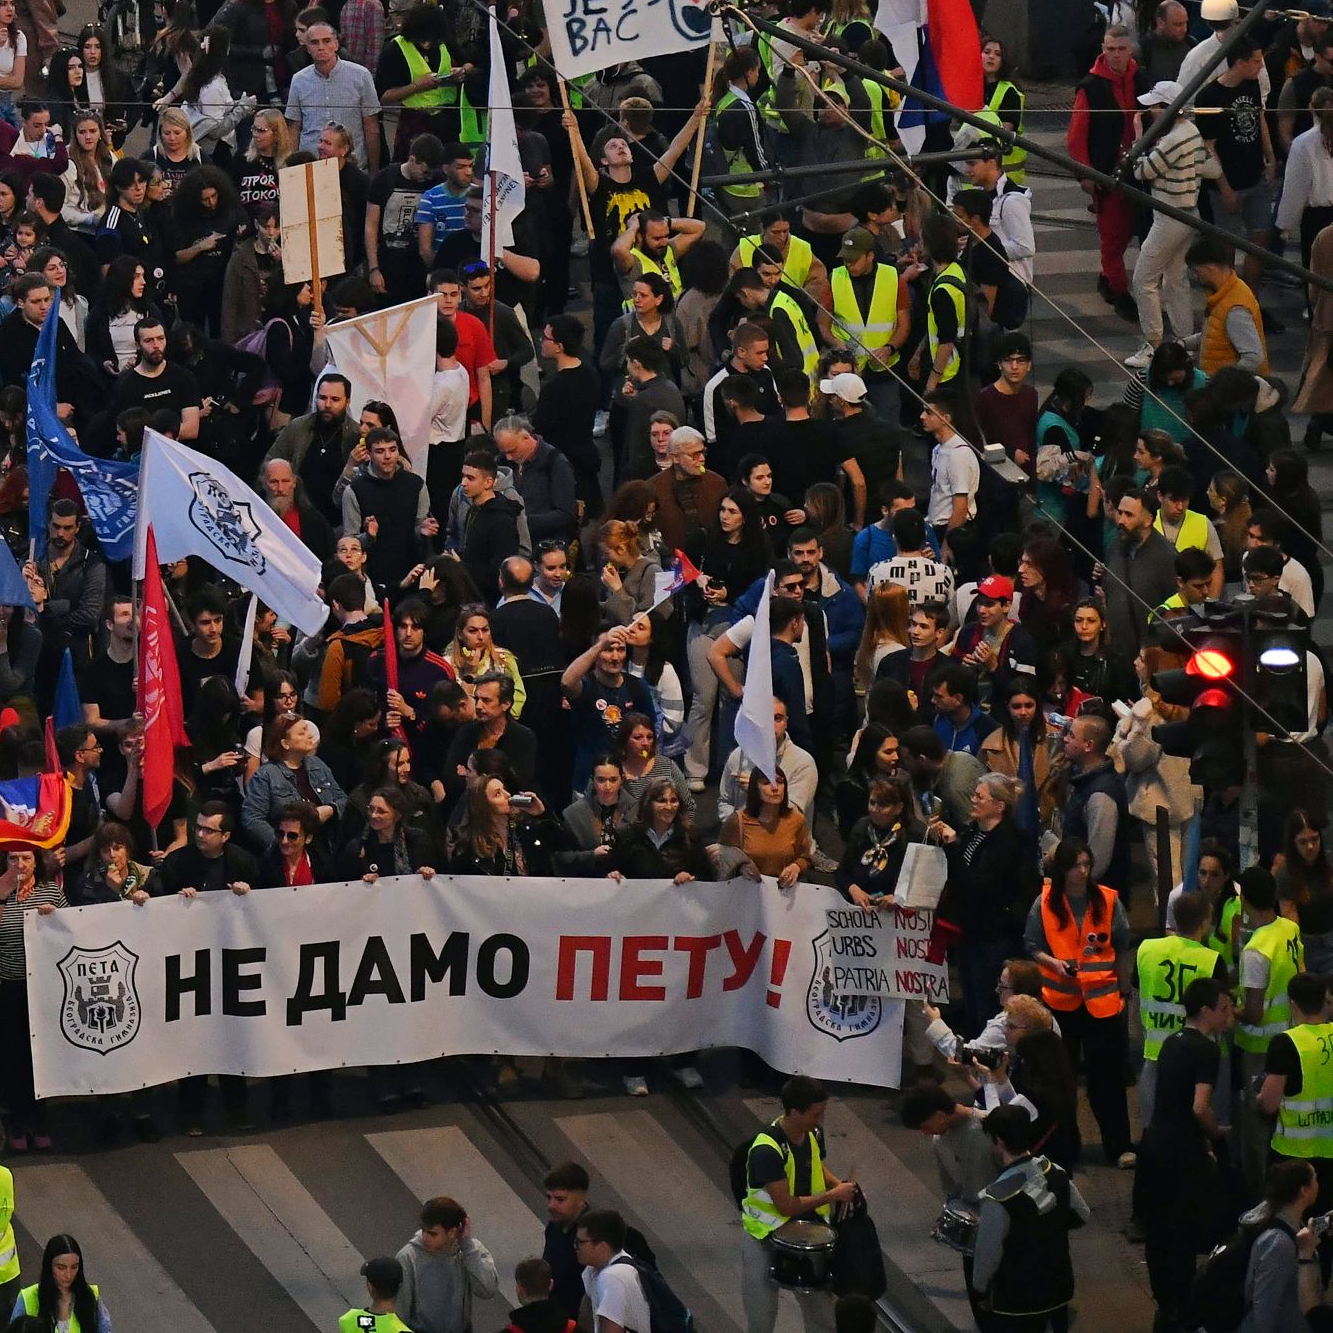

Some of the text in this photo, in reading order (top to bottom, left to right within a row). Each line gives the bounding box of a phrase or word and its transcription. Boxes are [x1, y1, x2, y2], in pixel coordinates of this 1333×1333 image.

[566, 8, 640, 57] ВАС
[241, 174, 276, 187] OTPOR
[828, 909, 882, 929] SCHOLA
[832, 935, 877, 958] URBS
[77, 959, 119, 980] ПЕТА
[164, 929, 792, 1027] НЕ ДАМО ПЕТУ!
[834, 967, 949, 1000] PATRIA NOSTRA
